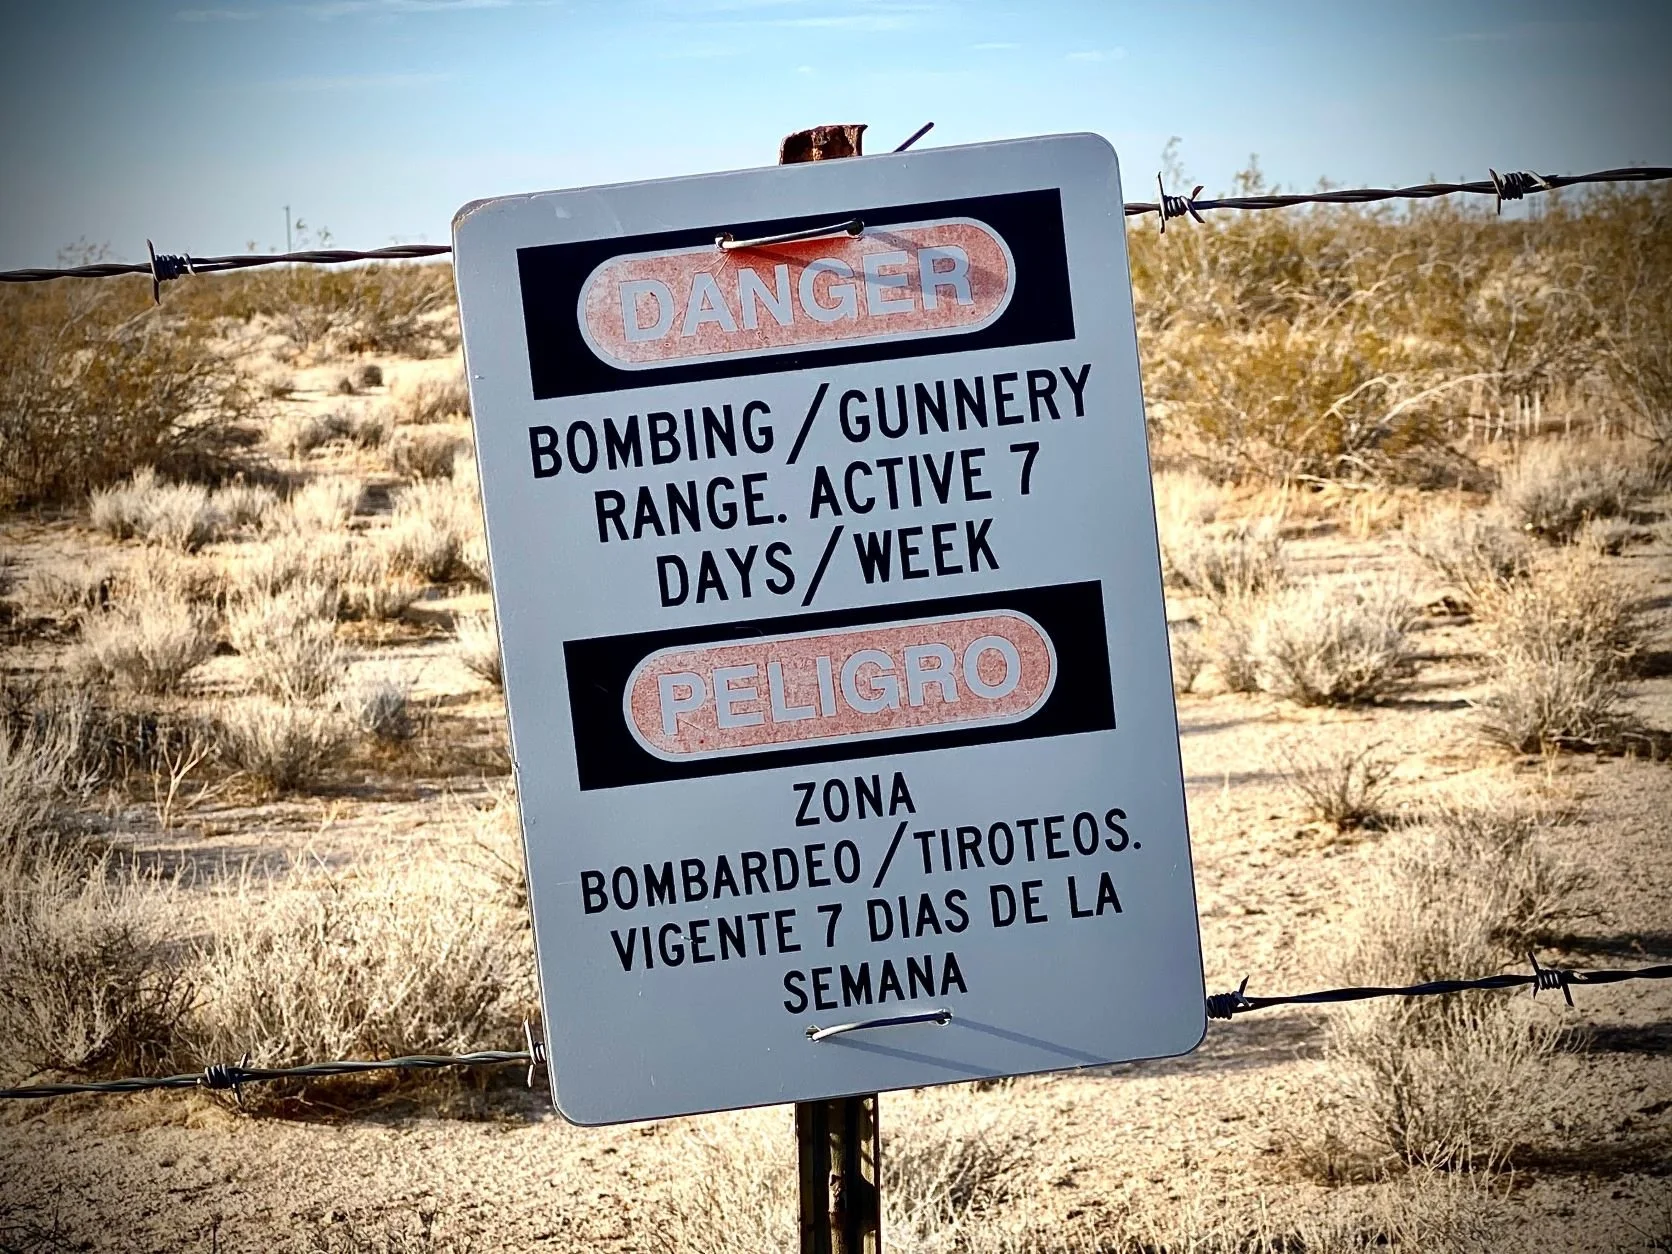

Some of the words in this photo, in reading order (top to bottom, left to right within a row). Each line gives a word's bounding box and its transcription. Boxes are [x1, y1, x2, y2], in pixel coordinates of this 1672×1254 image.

[618, 244, 975, 343] DANGER
[594, 471, 788, 543] RANGE.
[809, 447, 993, 520] ACTIVE
[1009, 441, 1040, 496] 7
[657, 635, 1022, 736] PELIGRO
[792, 771, 917, 827] ZONA
[610, 902, 802, 972] VIGENTE
[817, 902, 843, 948] 7
[866, 888, 970, 943] DIAS
[989, 879, 1049, 928] DE
[1067, 871, 1123, 919] LA
[783, 951, 969, 1015] SEMANA
